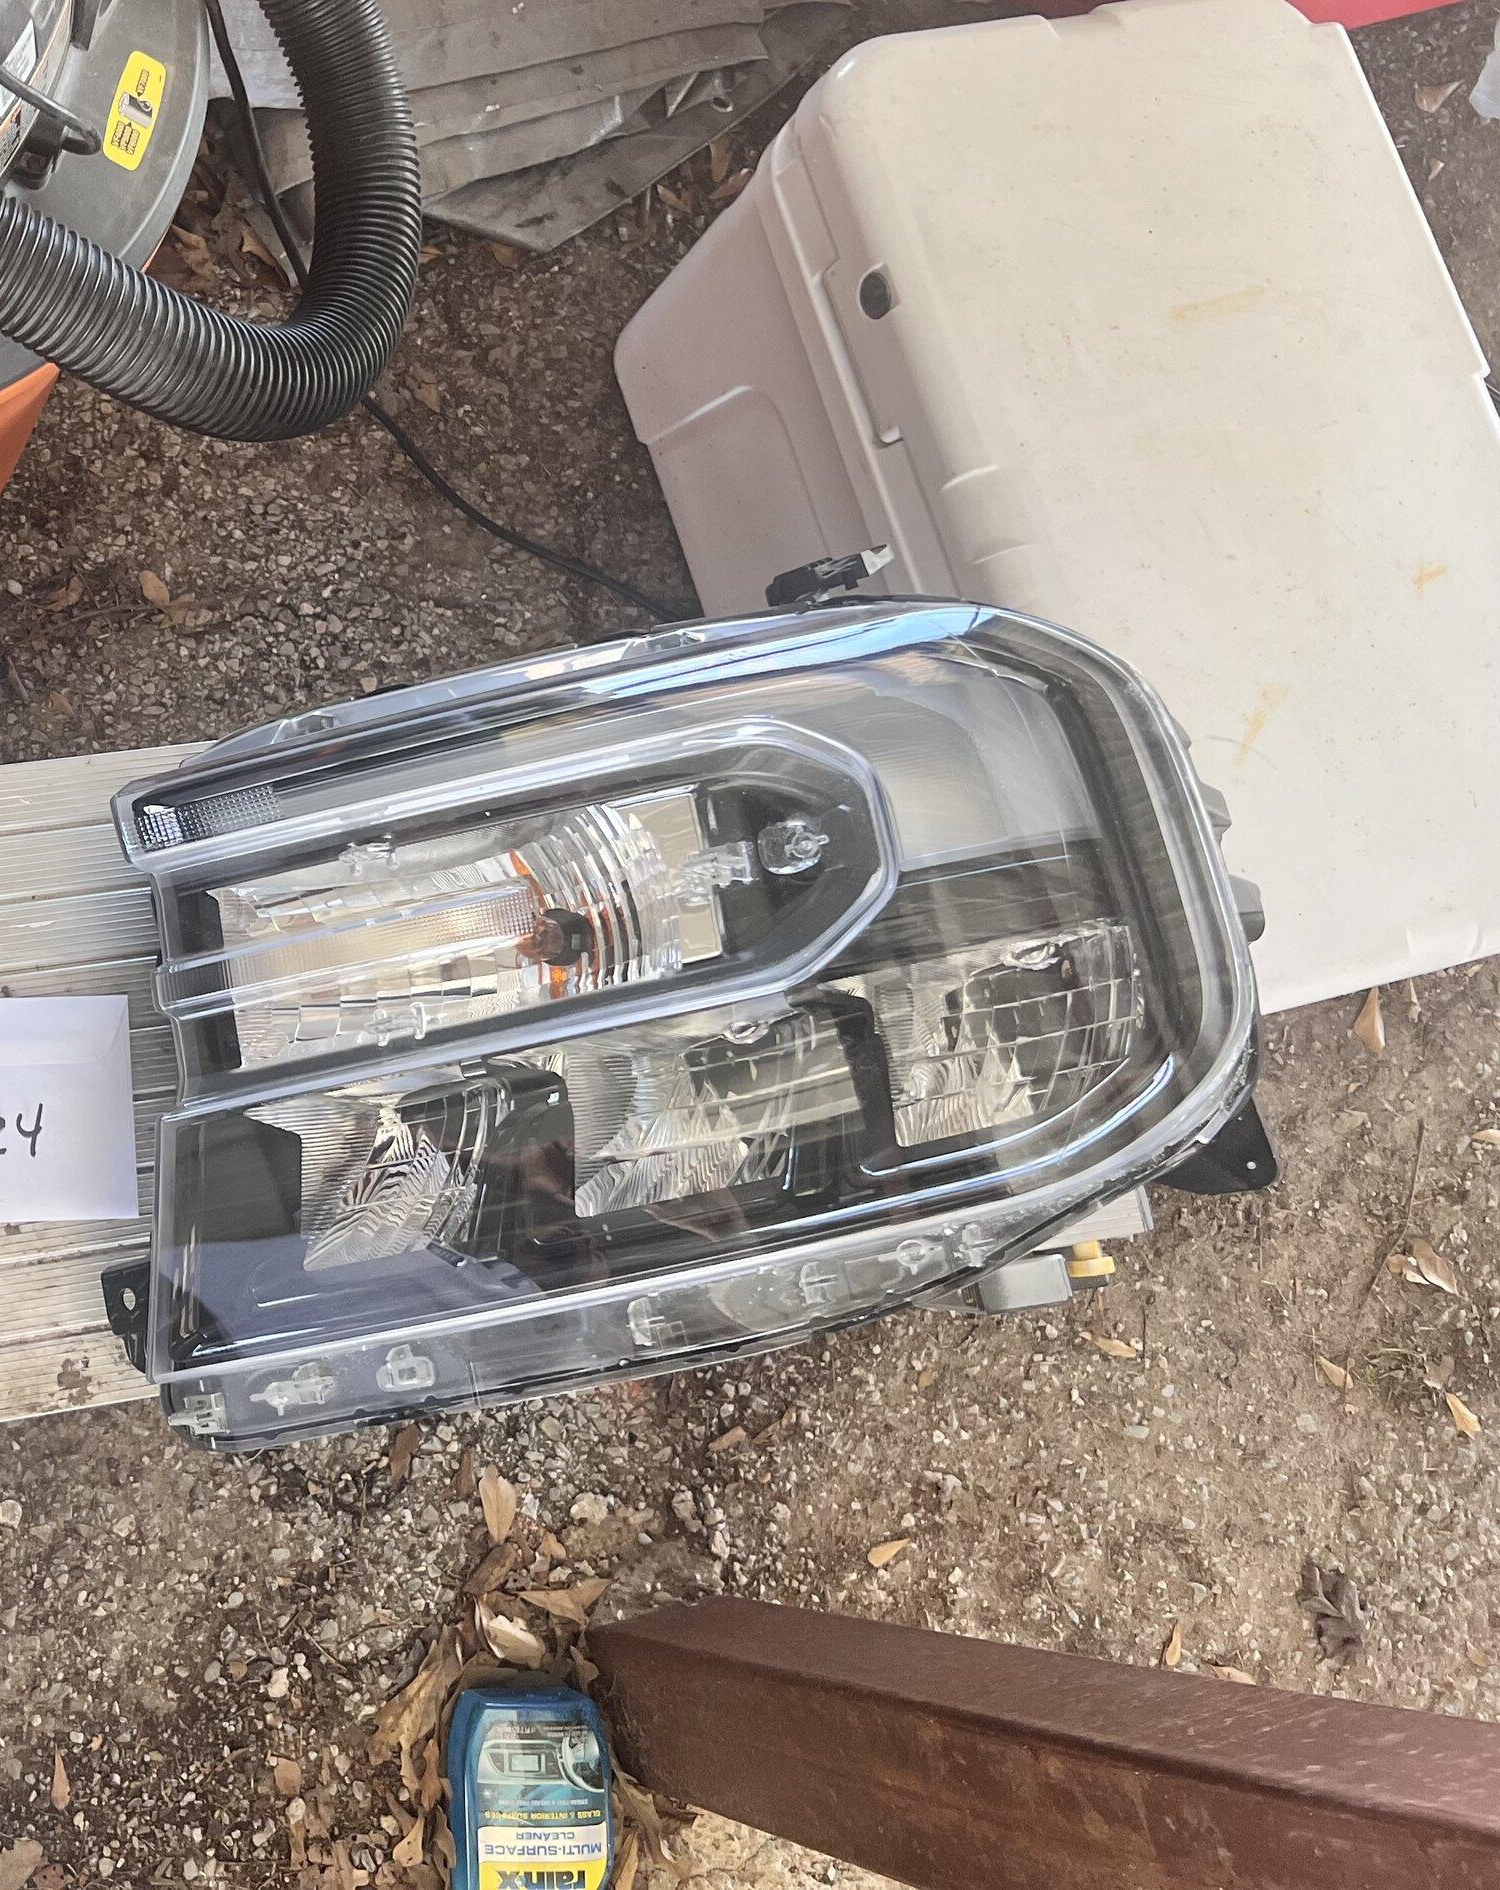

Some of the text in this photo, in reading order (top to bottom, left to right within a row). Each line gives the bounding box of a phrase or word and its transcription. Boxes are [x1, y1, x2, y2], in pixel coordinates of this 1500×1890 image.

[530, 1811, 568, 1820] INTERIOR
[516, 1831, 575, 1841] CLEANER
[484, 1842, 602, 1856] MULTI-SURFACE
